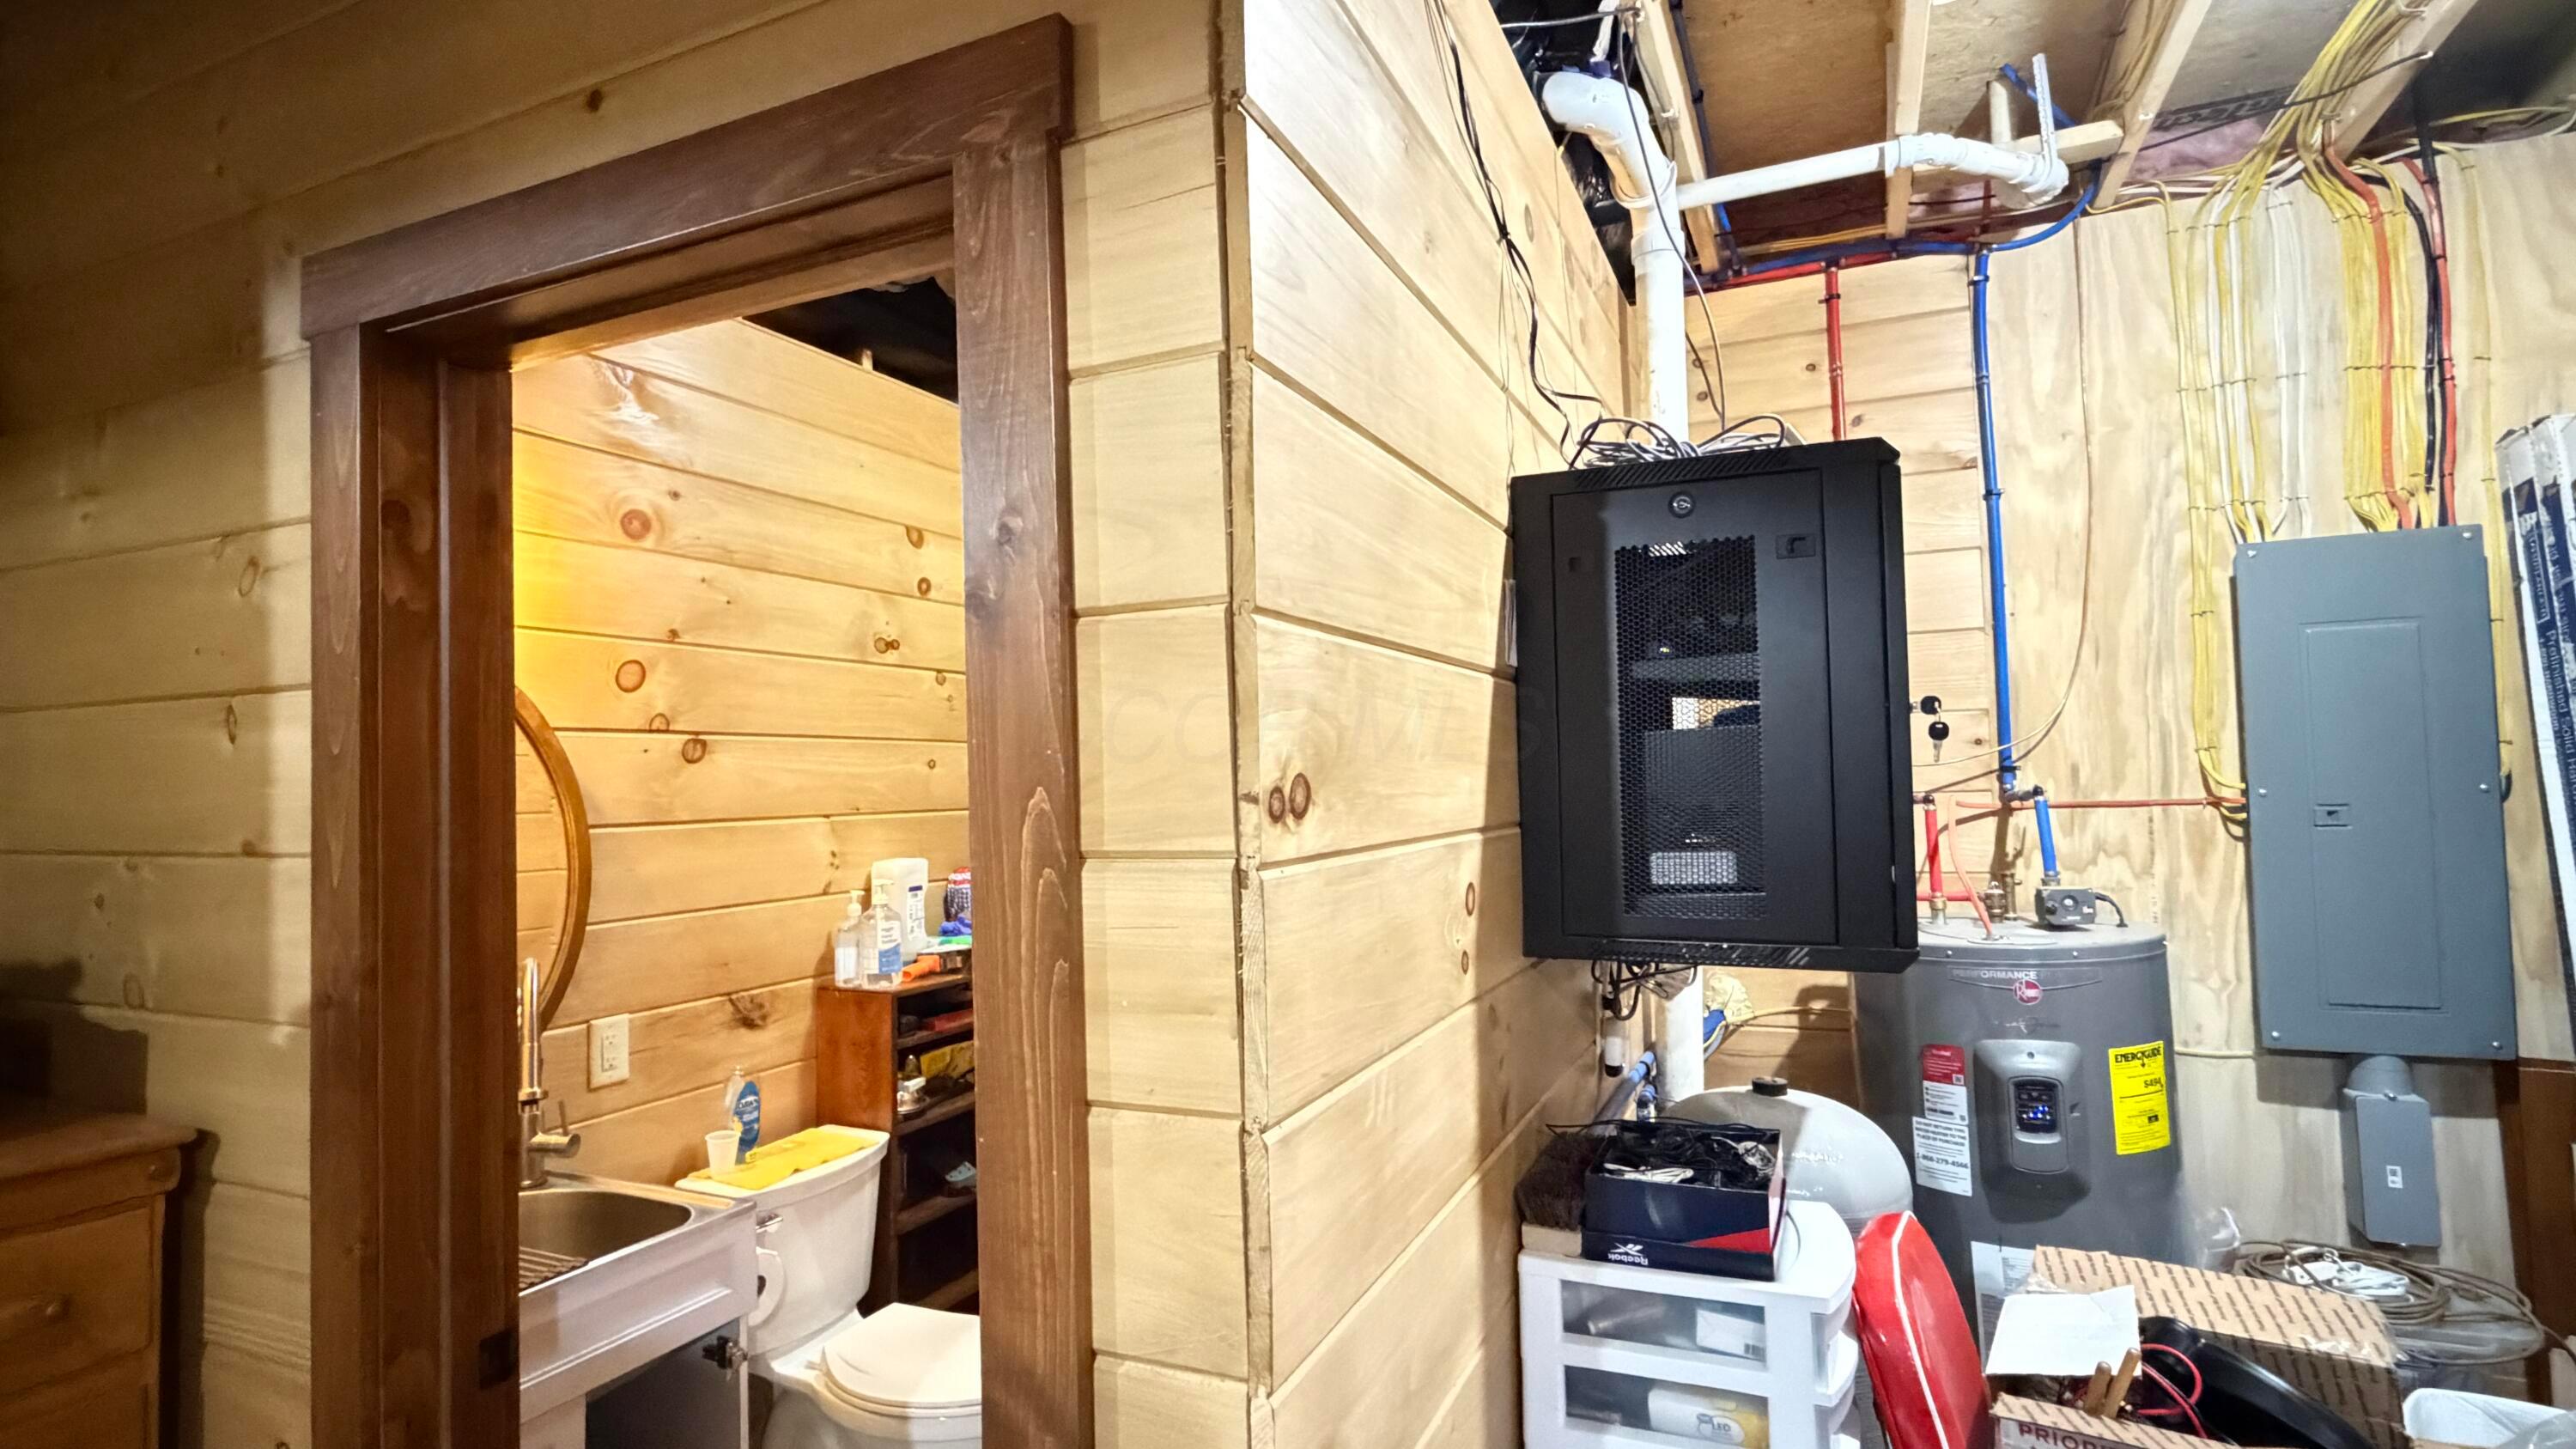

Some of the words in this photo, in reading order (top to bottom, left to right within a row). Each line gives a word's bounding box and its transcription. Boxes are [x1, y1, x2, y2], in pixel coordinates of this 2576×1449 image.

[2546, 630, 2568, 713] Prefinished
[2560, 716, 2575, 754] Solid
[1953, 968, 2038, 980] PERFORMANCE
[1607, 1253, 1649, 1266] Reebok
